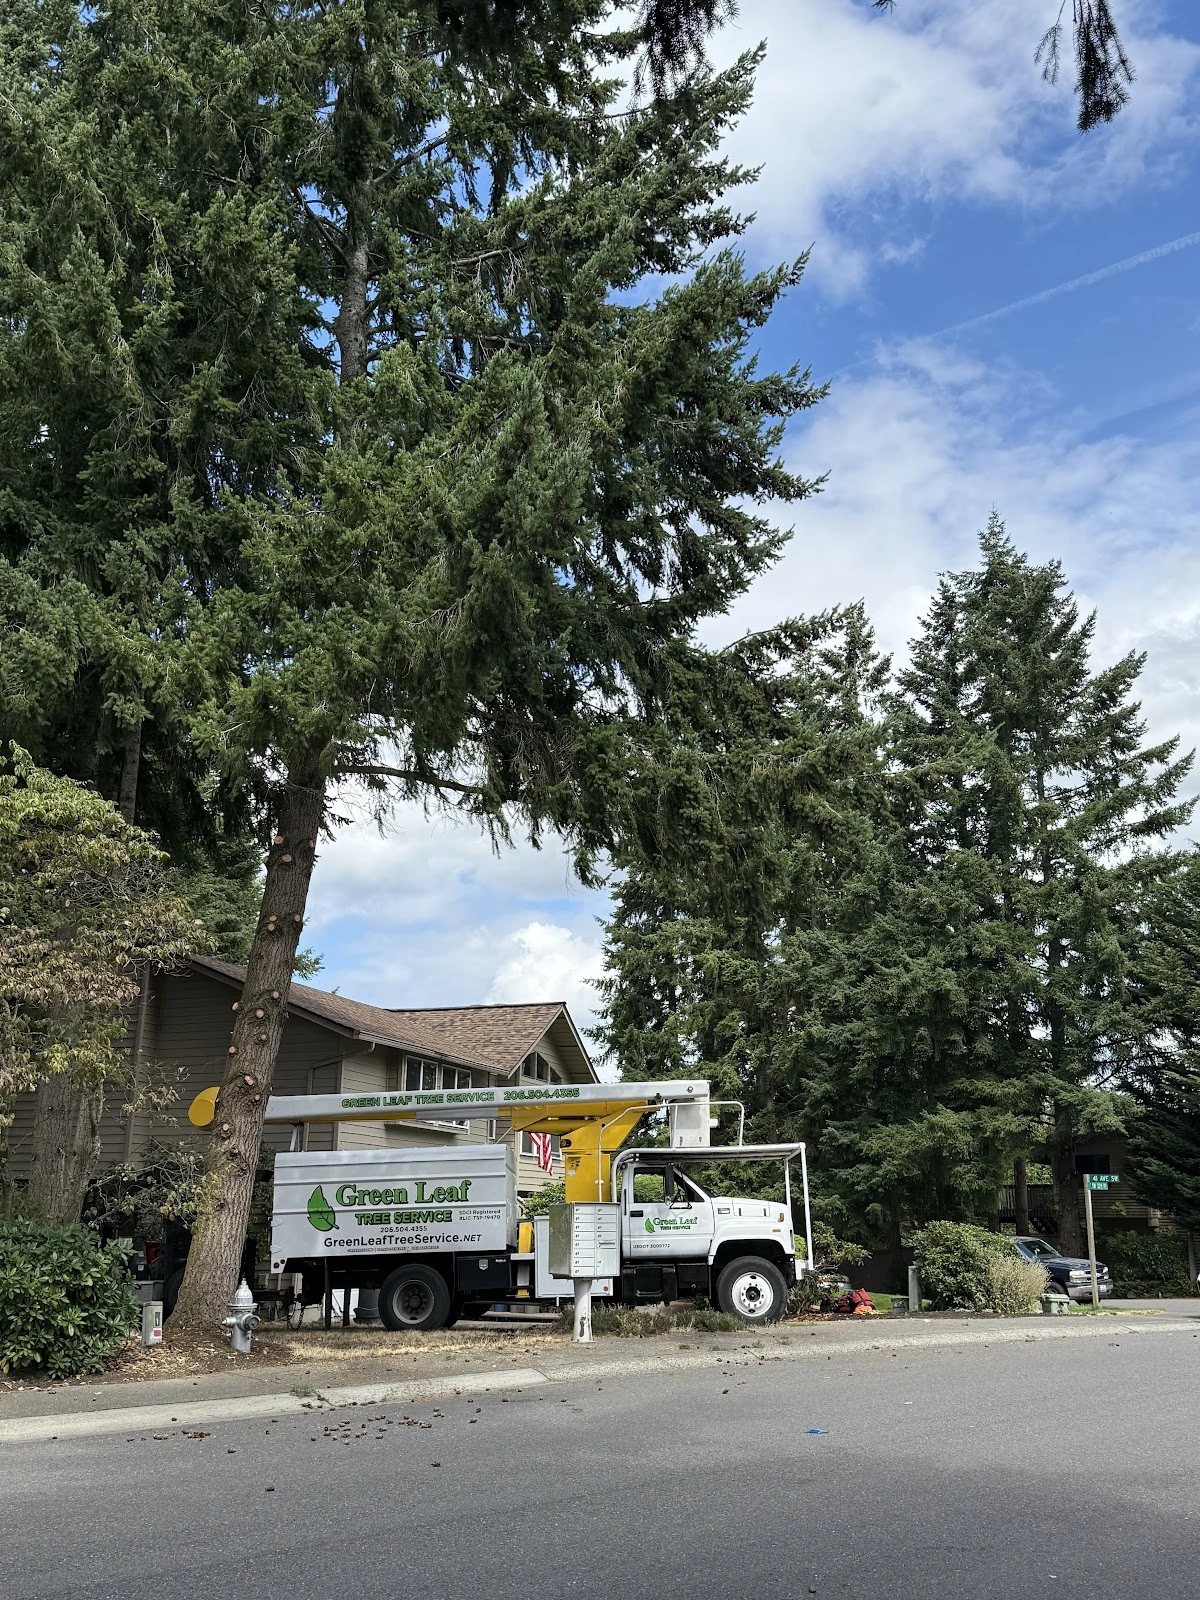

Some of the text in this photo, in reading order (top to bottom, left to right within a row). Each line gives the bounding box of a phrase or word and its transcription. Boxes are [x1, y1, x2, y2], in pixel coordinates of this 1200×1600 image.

[342, 1088, 580, 1108] GREEN LEAF TREE SERVICE 206.504.4355
[335, 1180, 472, 1207] Green Leaf
[355, 1210, 453, 1226] TREE SERVICE
[653, 1216, 698, 1226] Green Leaf
